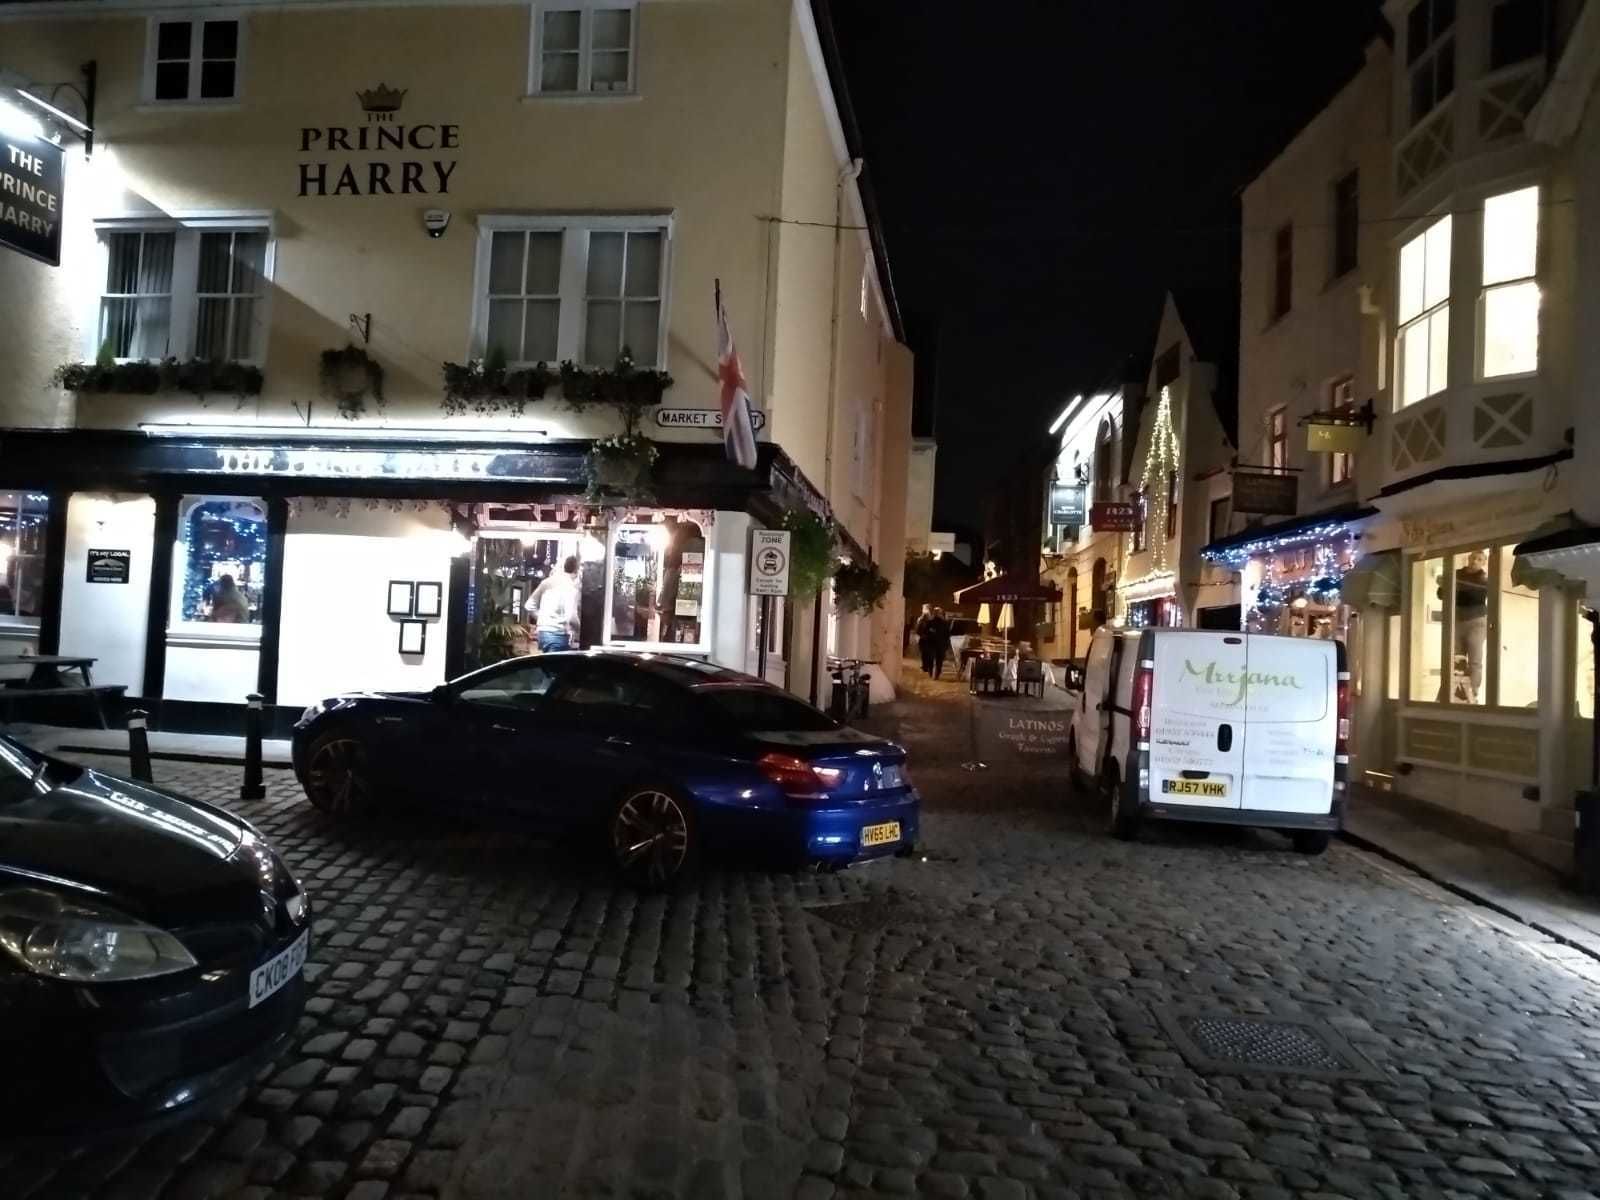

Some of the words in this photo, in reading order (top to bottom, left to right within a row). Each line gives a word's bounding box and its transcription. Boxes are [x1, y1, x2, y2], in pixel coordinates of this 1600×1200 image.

[367, 112, 394, 122] THE
[299, 124, 460, 151] PRINCE
[7, 143, 44, 177] THE
[298, 160, 457, 197] HARRY
[662, 412, 707, 425] MARKET
[761, 536, 783, 544] ZONE
[1008, 718, 1064, 732] LATINOS
[1169, 780, 1199, 794] RJ57
[1203, 782, 1225, 795] VHK
[864, 825, 883, 843] HV65
[885, 823, 898, 839] LHC
